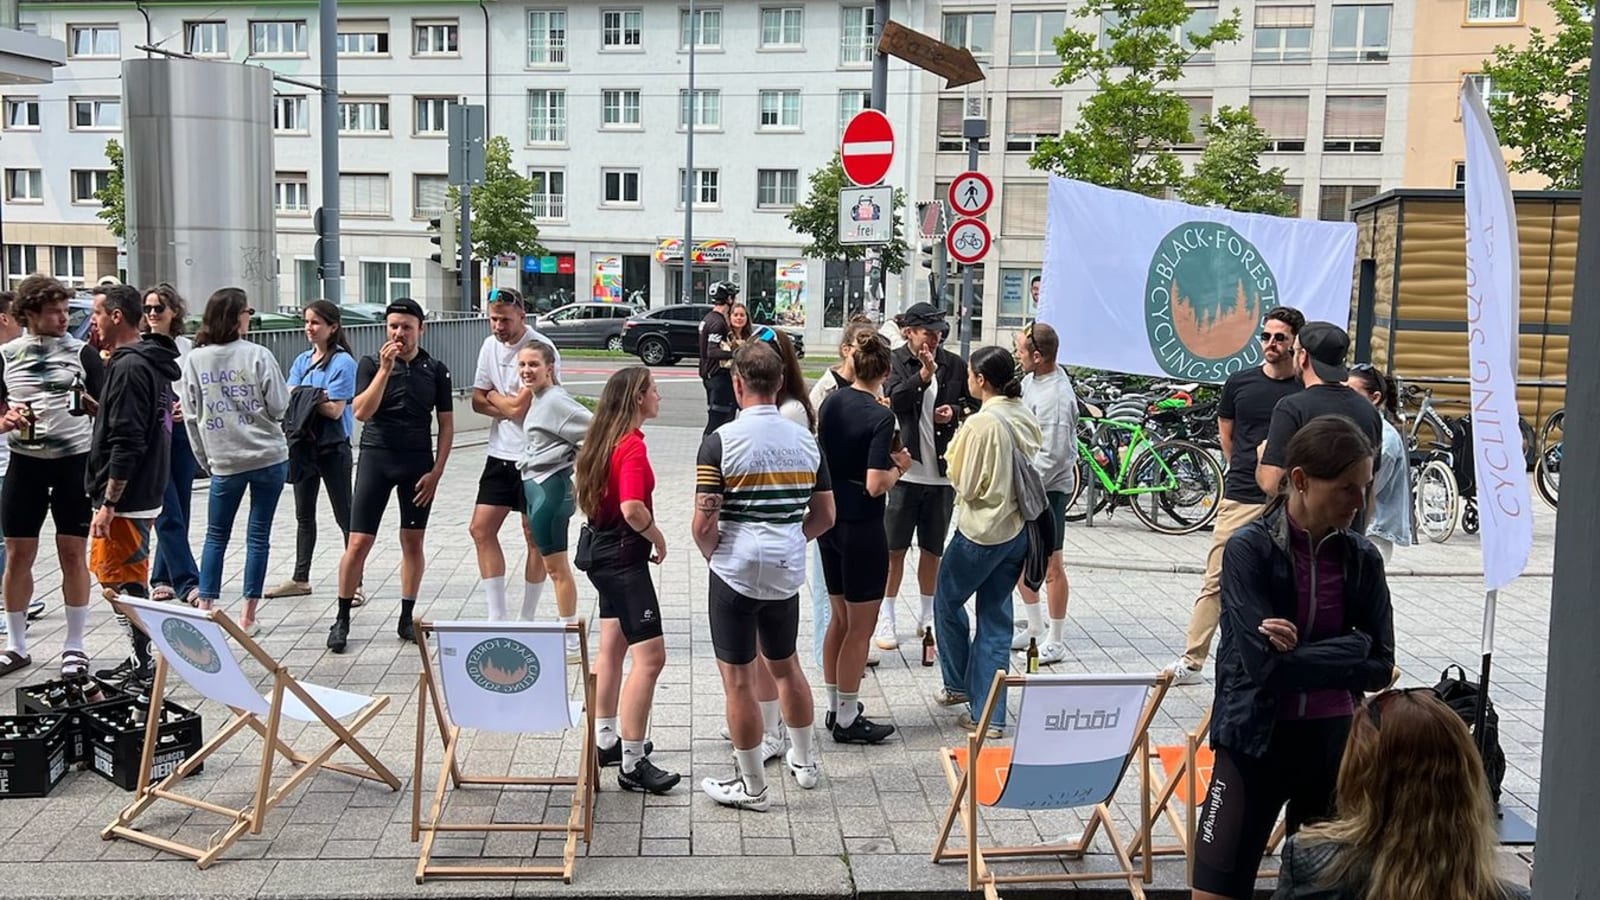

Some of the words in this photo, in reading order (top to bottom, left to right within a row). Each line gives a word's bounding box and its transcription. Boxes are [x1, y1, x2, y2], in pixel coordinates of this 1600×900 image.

[857, 225, 873, 236] frei
[1156, 228, 1208, 281] BLACK
[1215, 230, 1275, 304] FOREST
[1151, 286, 1206, 379] CYCLING
[201, 369, 246, 385] BLACK
[1472, 360, 1520, 517] CYCLING
